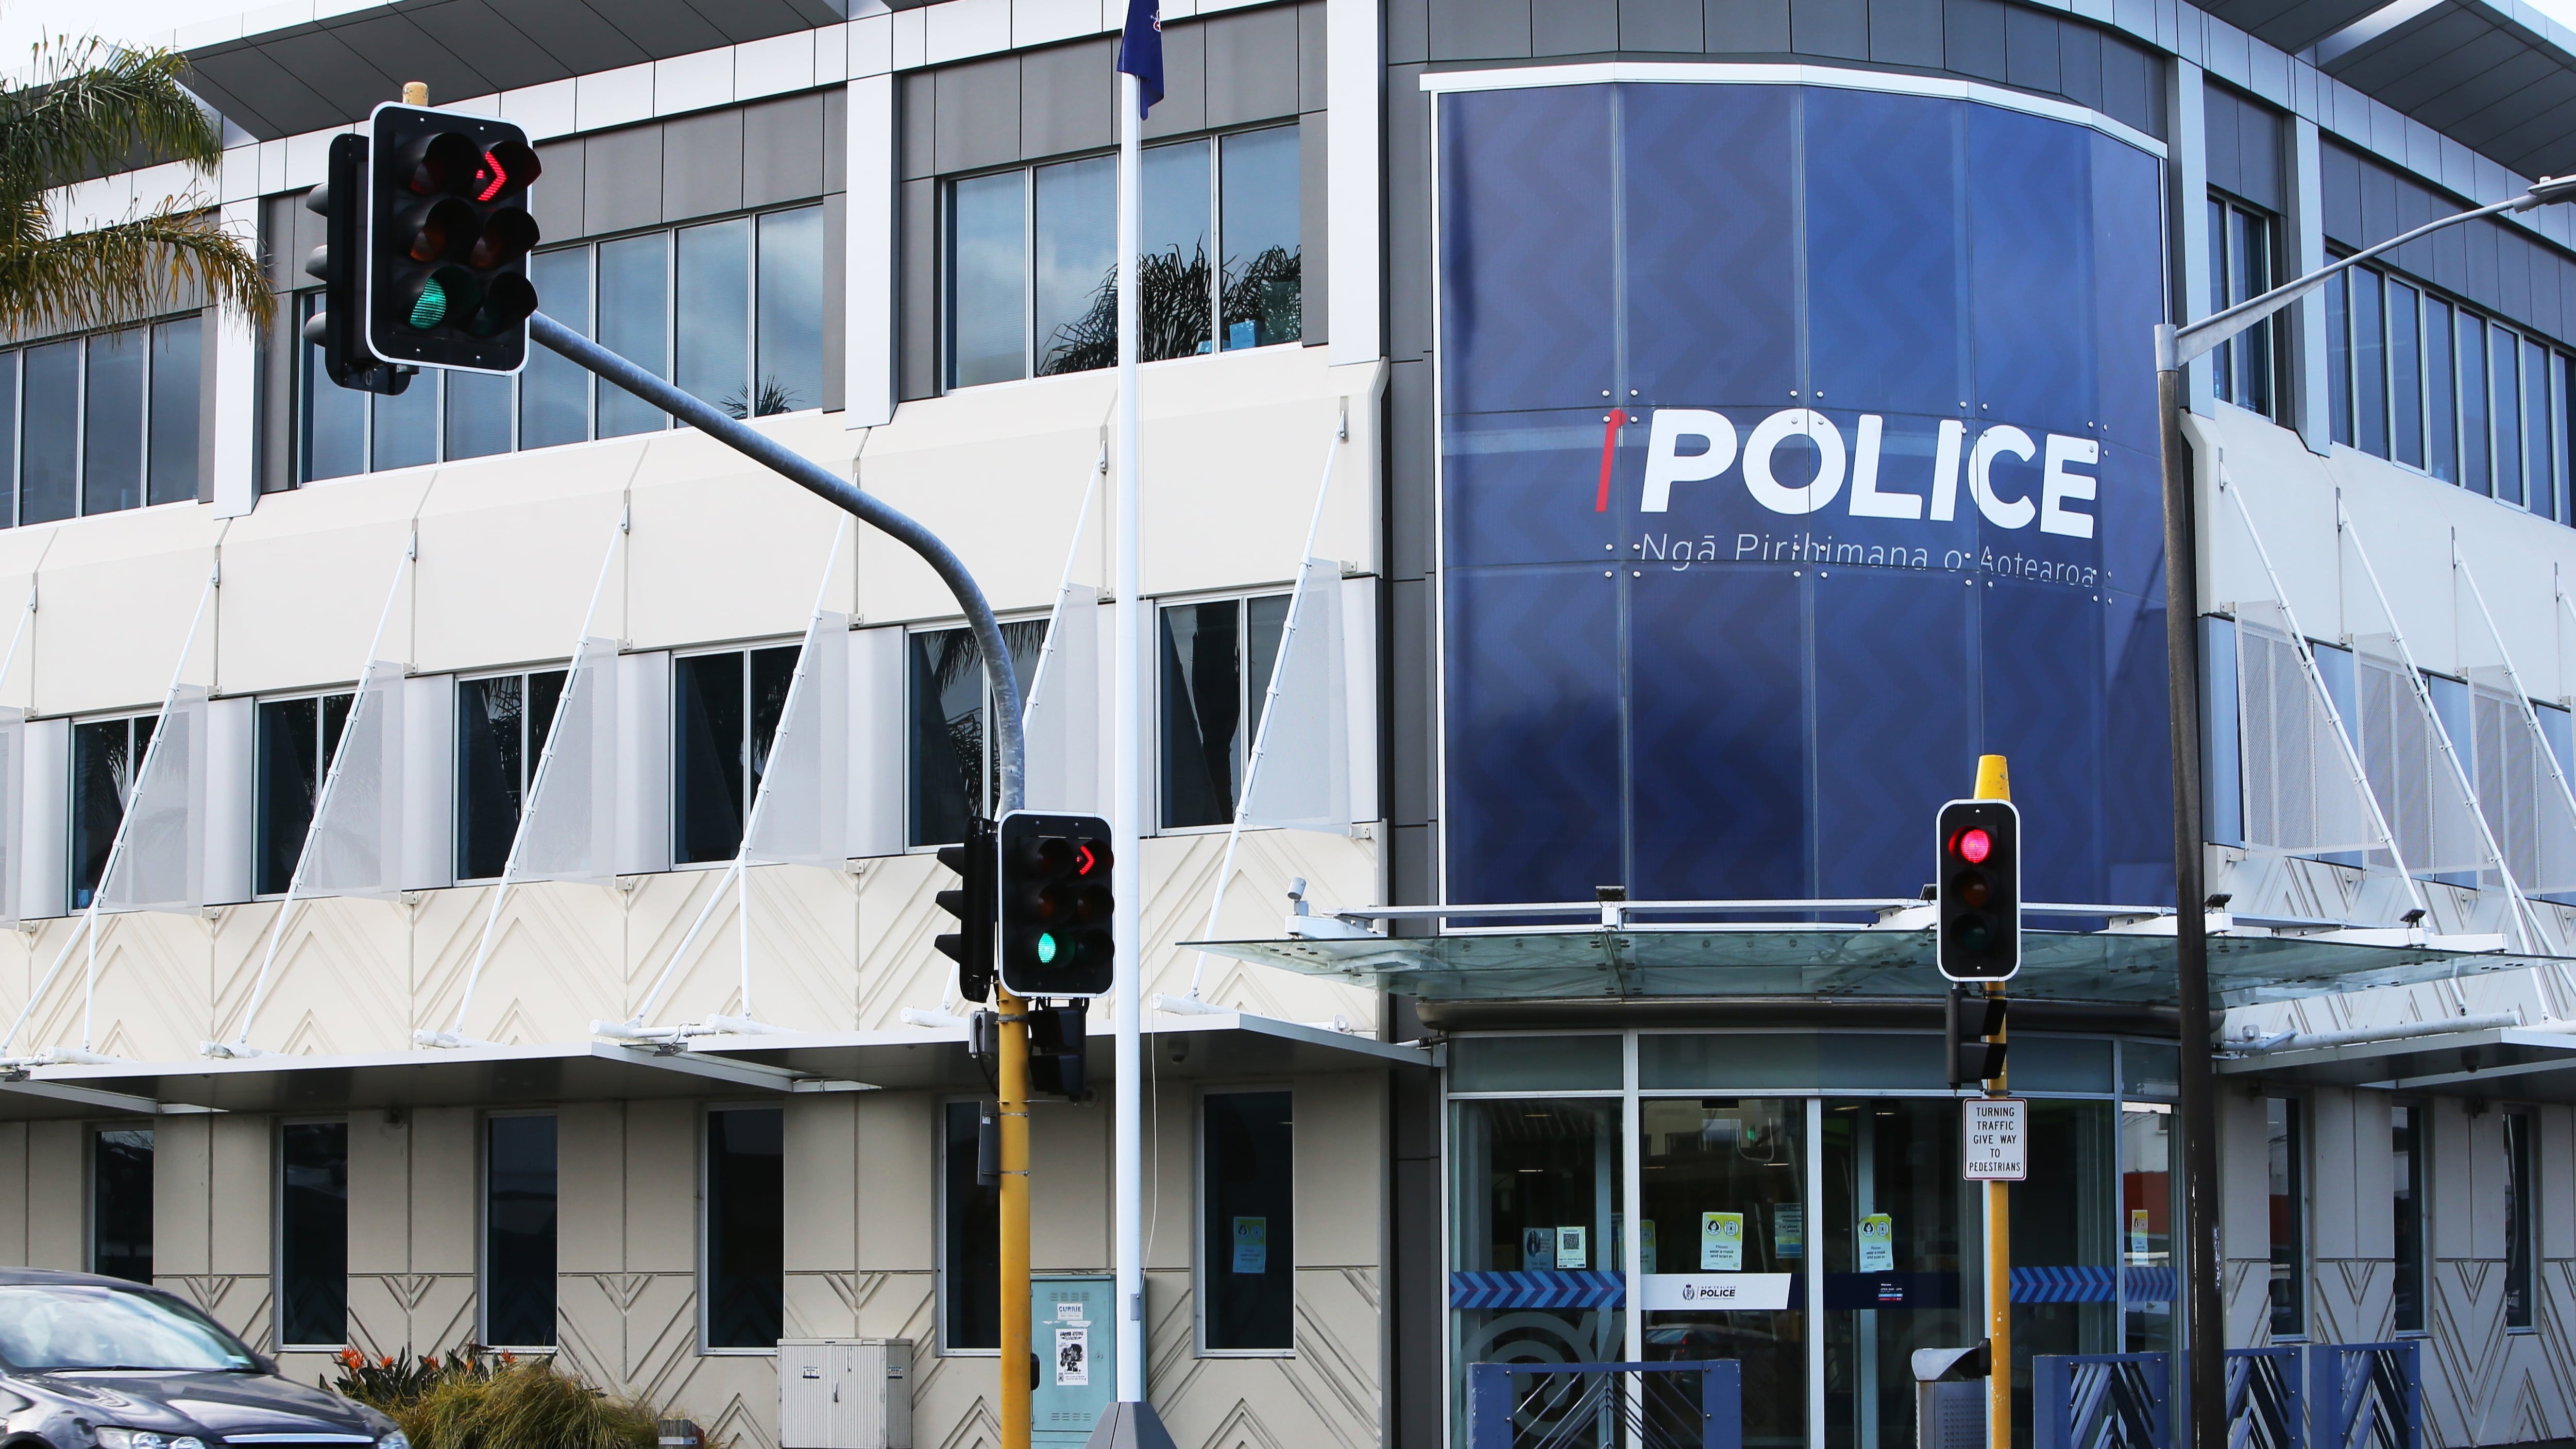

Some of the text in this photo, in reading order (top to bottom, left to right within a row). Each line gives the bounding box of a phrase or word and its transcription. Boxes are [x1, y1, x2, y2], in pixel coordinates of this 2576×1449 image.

[1640, 408, 2099, 539] POLICE
[1641, 532, 2093, 587] Ngā Pirihimana o Aotearoa
[1976, 1107, 2014, 1117] TURNING
[1977, 1121, 2014, 1130] TRAFFIC
[1973, 1135, 2016, 1144] GIVE WAY
[1990, 1148, 2000, 1158] TO
[1969, 1162, 2021, 1172] PEDESTRIANS
